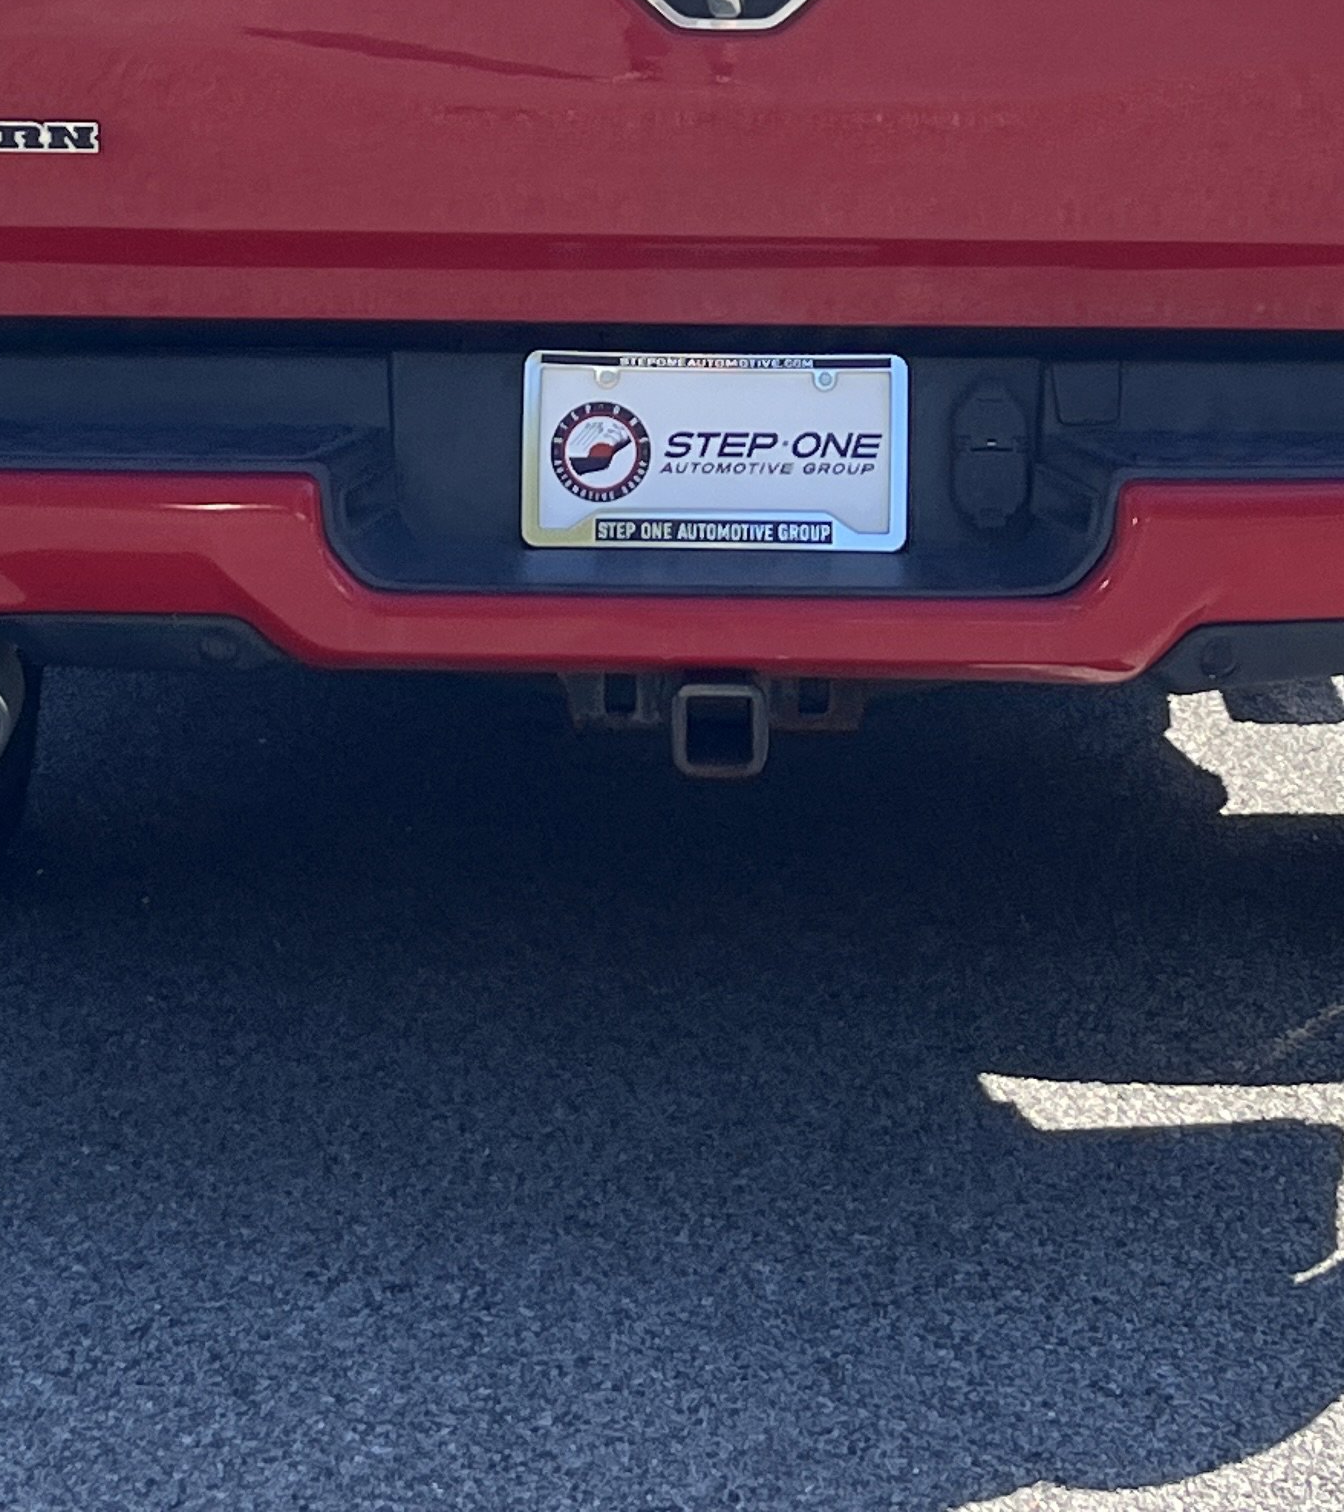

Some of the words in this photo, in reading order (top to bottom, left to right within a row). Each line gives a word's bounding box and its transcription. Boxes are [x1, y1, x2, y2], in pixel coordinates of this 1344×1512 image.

[619, 355, 814, 369] STEPONEAUTOMOTIVE.COM
[660, 461, 793, 476] AUTOMOTIVE
[803, 462, 876, 476] GROUP
[597, 521, 637, 539] STEP
[641, 522, 673, 540] ONE
[677, 522, 774, 541] AUTOMOTIVE
[778, 523, 831, 542] GROUP
